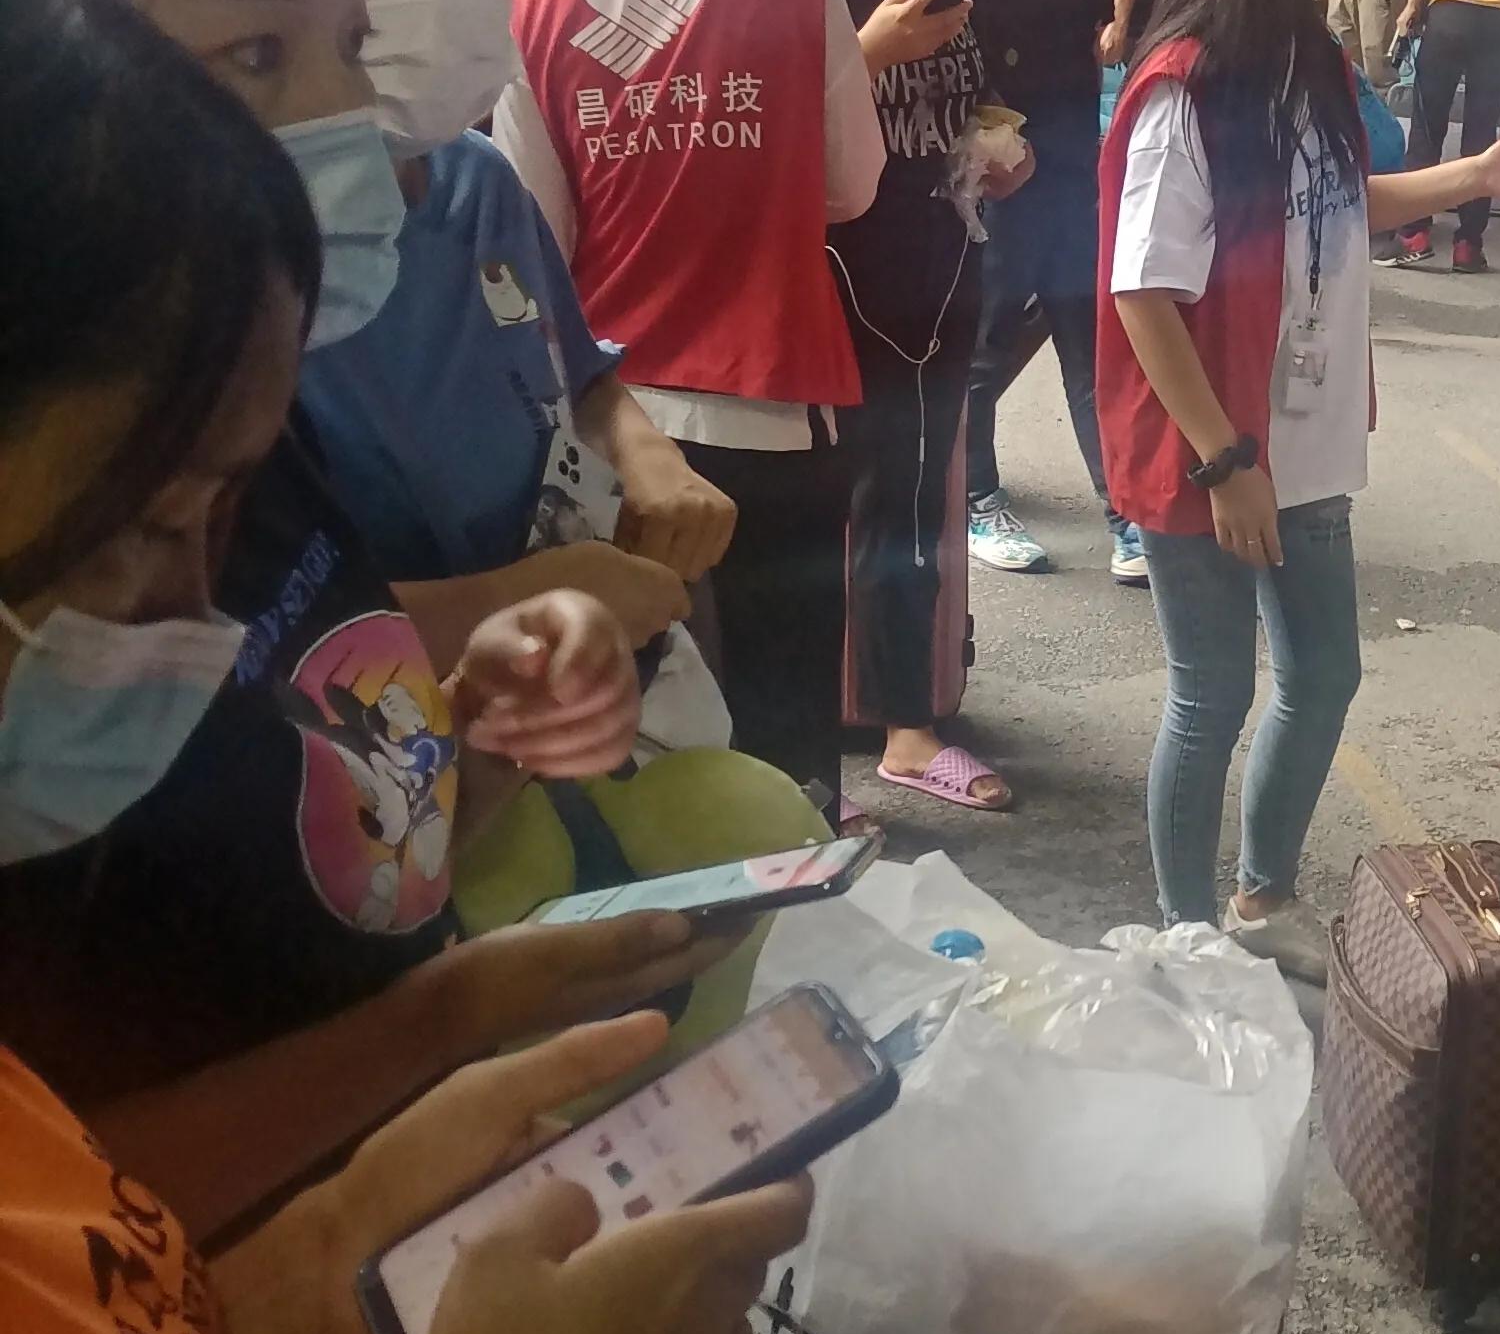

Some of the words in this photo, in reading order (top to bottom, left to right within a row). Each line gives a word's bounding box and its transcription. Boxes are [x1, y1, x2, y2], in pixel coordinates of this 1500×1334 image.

[575, 71, 763, 130] 昌硕科技
[872, 53, 973, 104] WHERE
[584, 120, 762, 163] PEGATRON
